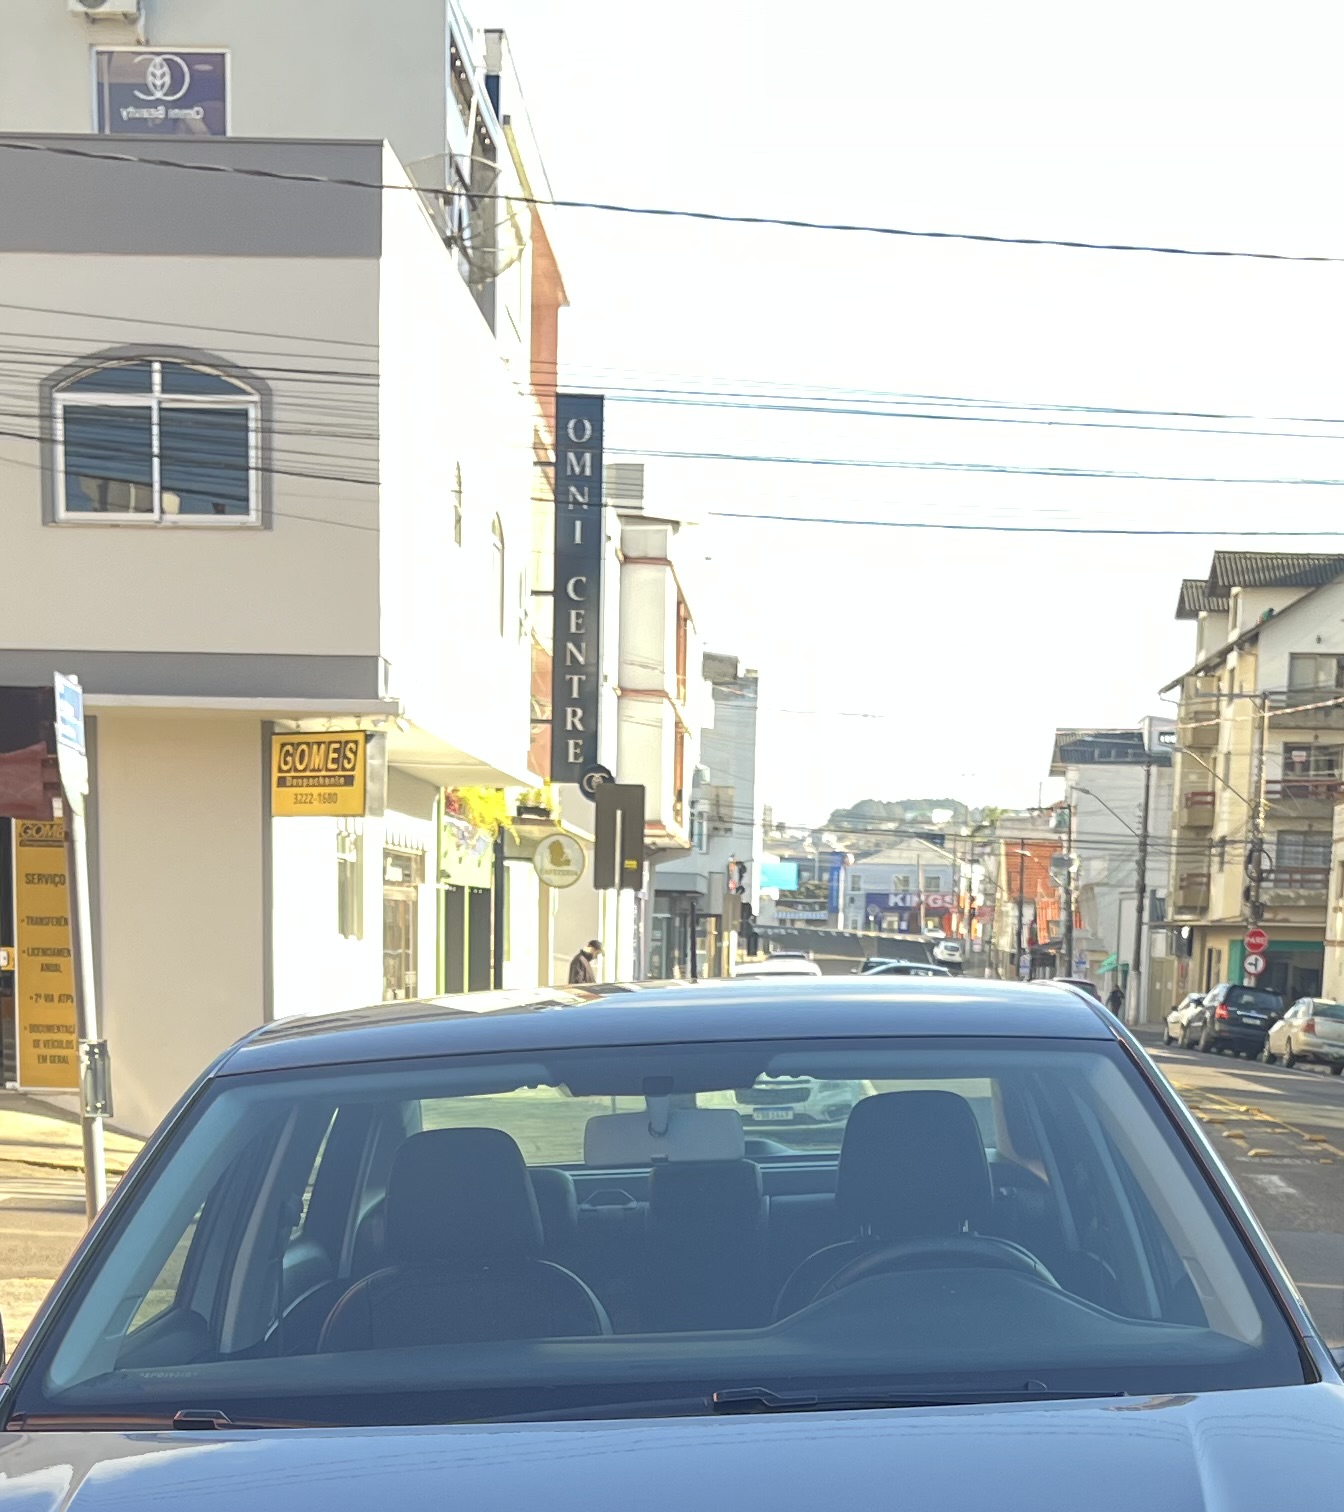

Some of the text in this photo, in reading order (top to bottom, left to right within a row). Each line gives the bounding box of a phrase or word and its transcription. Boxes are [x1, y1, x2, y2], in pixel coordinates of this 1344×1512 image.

[564, 417, 593, 764] OMNI CENTRE
[279, 742, 358, 771] GOMES
[888, 894, 955, 907] KINGS
